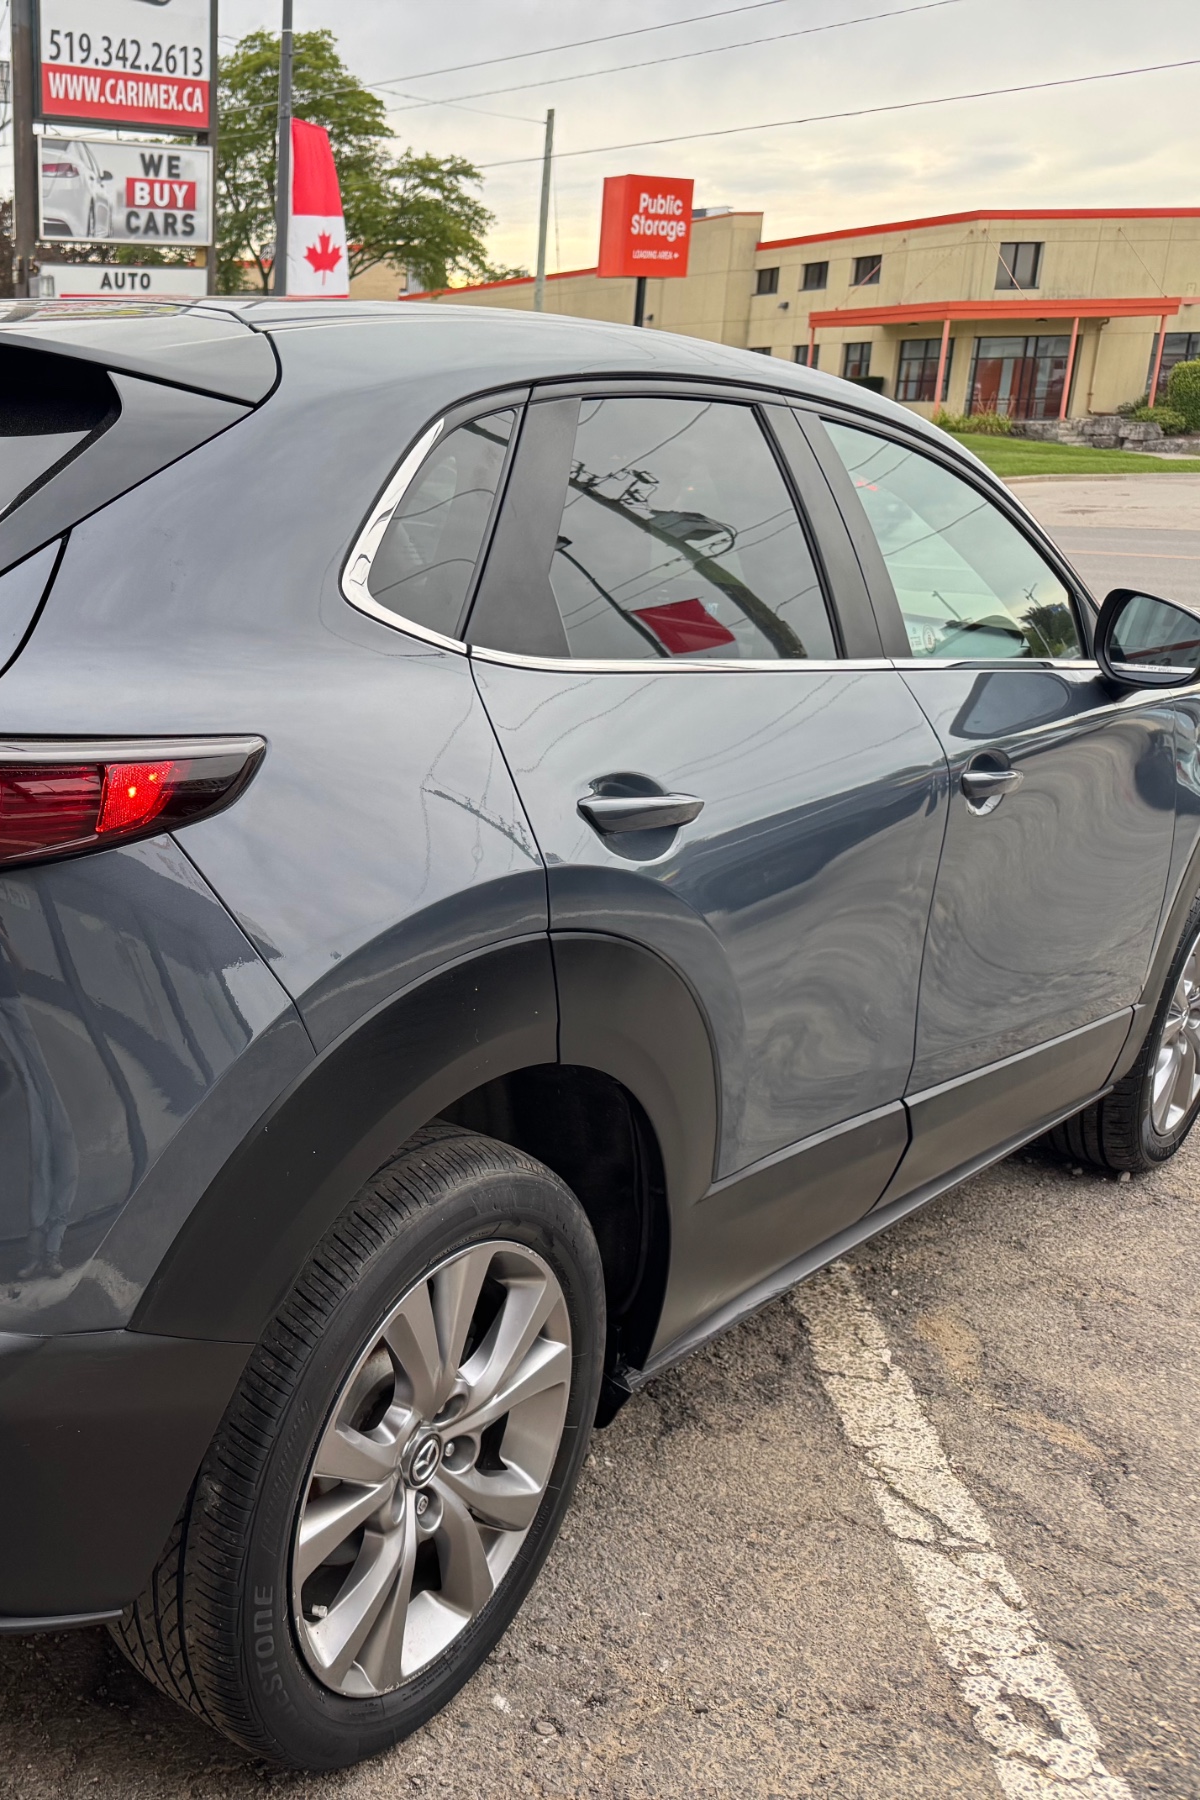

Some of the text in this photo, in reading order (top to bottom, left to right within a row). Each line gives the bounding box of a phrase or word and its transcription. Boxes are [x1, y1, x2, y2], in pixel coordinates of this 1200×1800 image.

[49, 29, 203, 77] 519.342.2613
[48, 71, 204, 113] WWW.CARIMEX.CA
[140, 153, 181, 178] WE
[133, 181, 189, 208] BUY
[639, 192, 683, 216] Public
[125, 210, 195, 237] CARS
[630, 213, 687, 242] Storage
[100, 271, 151, 290] AUTO
